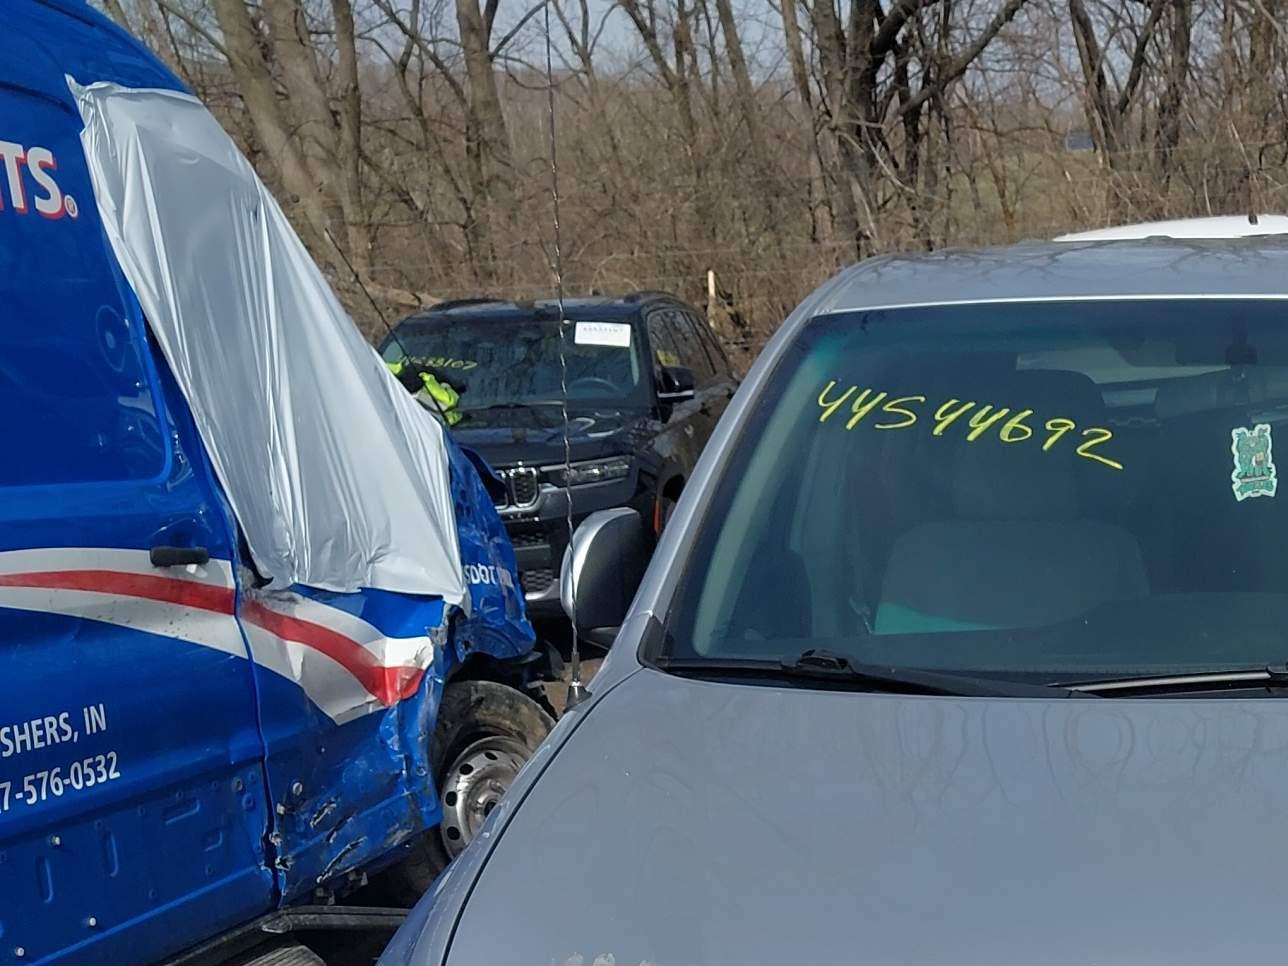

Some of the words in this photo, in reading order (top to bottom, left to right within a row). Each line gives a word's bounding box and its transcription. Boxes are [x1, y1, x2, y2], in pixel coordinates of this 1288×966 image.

[818, 380, 1124, 469] 44544692
[0, 711, 78, 757] SHERS,
[83, 703, 107, 735] IN
[0, 751, 120, 813] 7-576-0532
